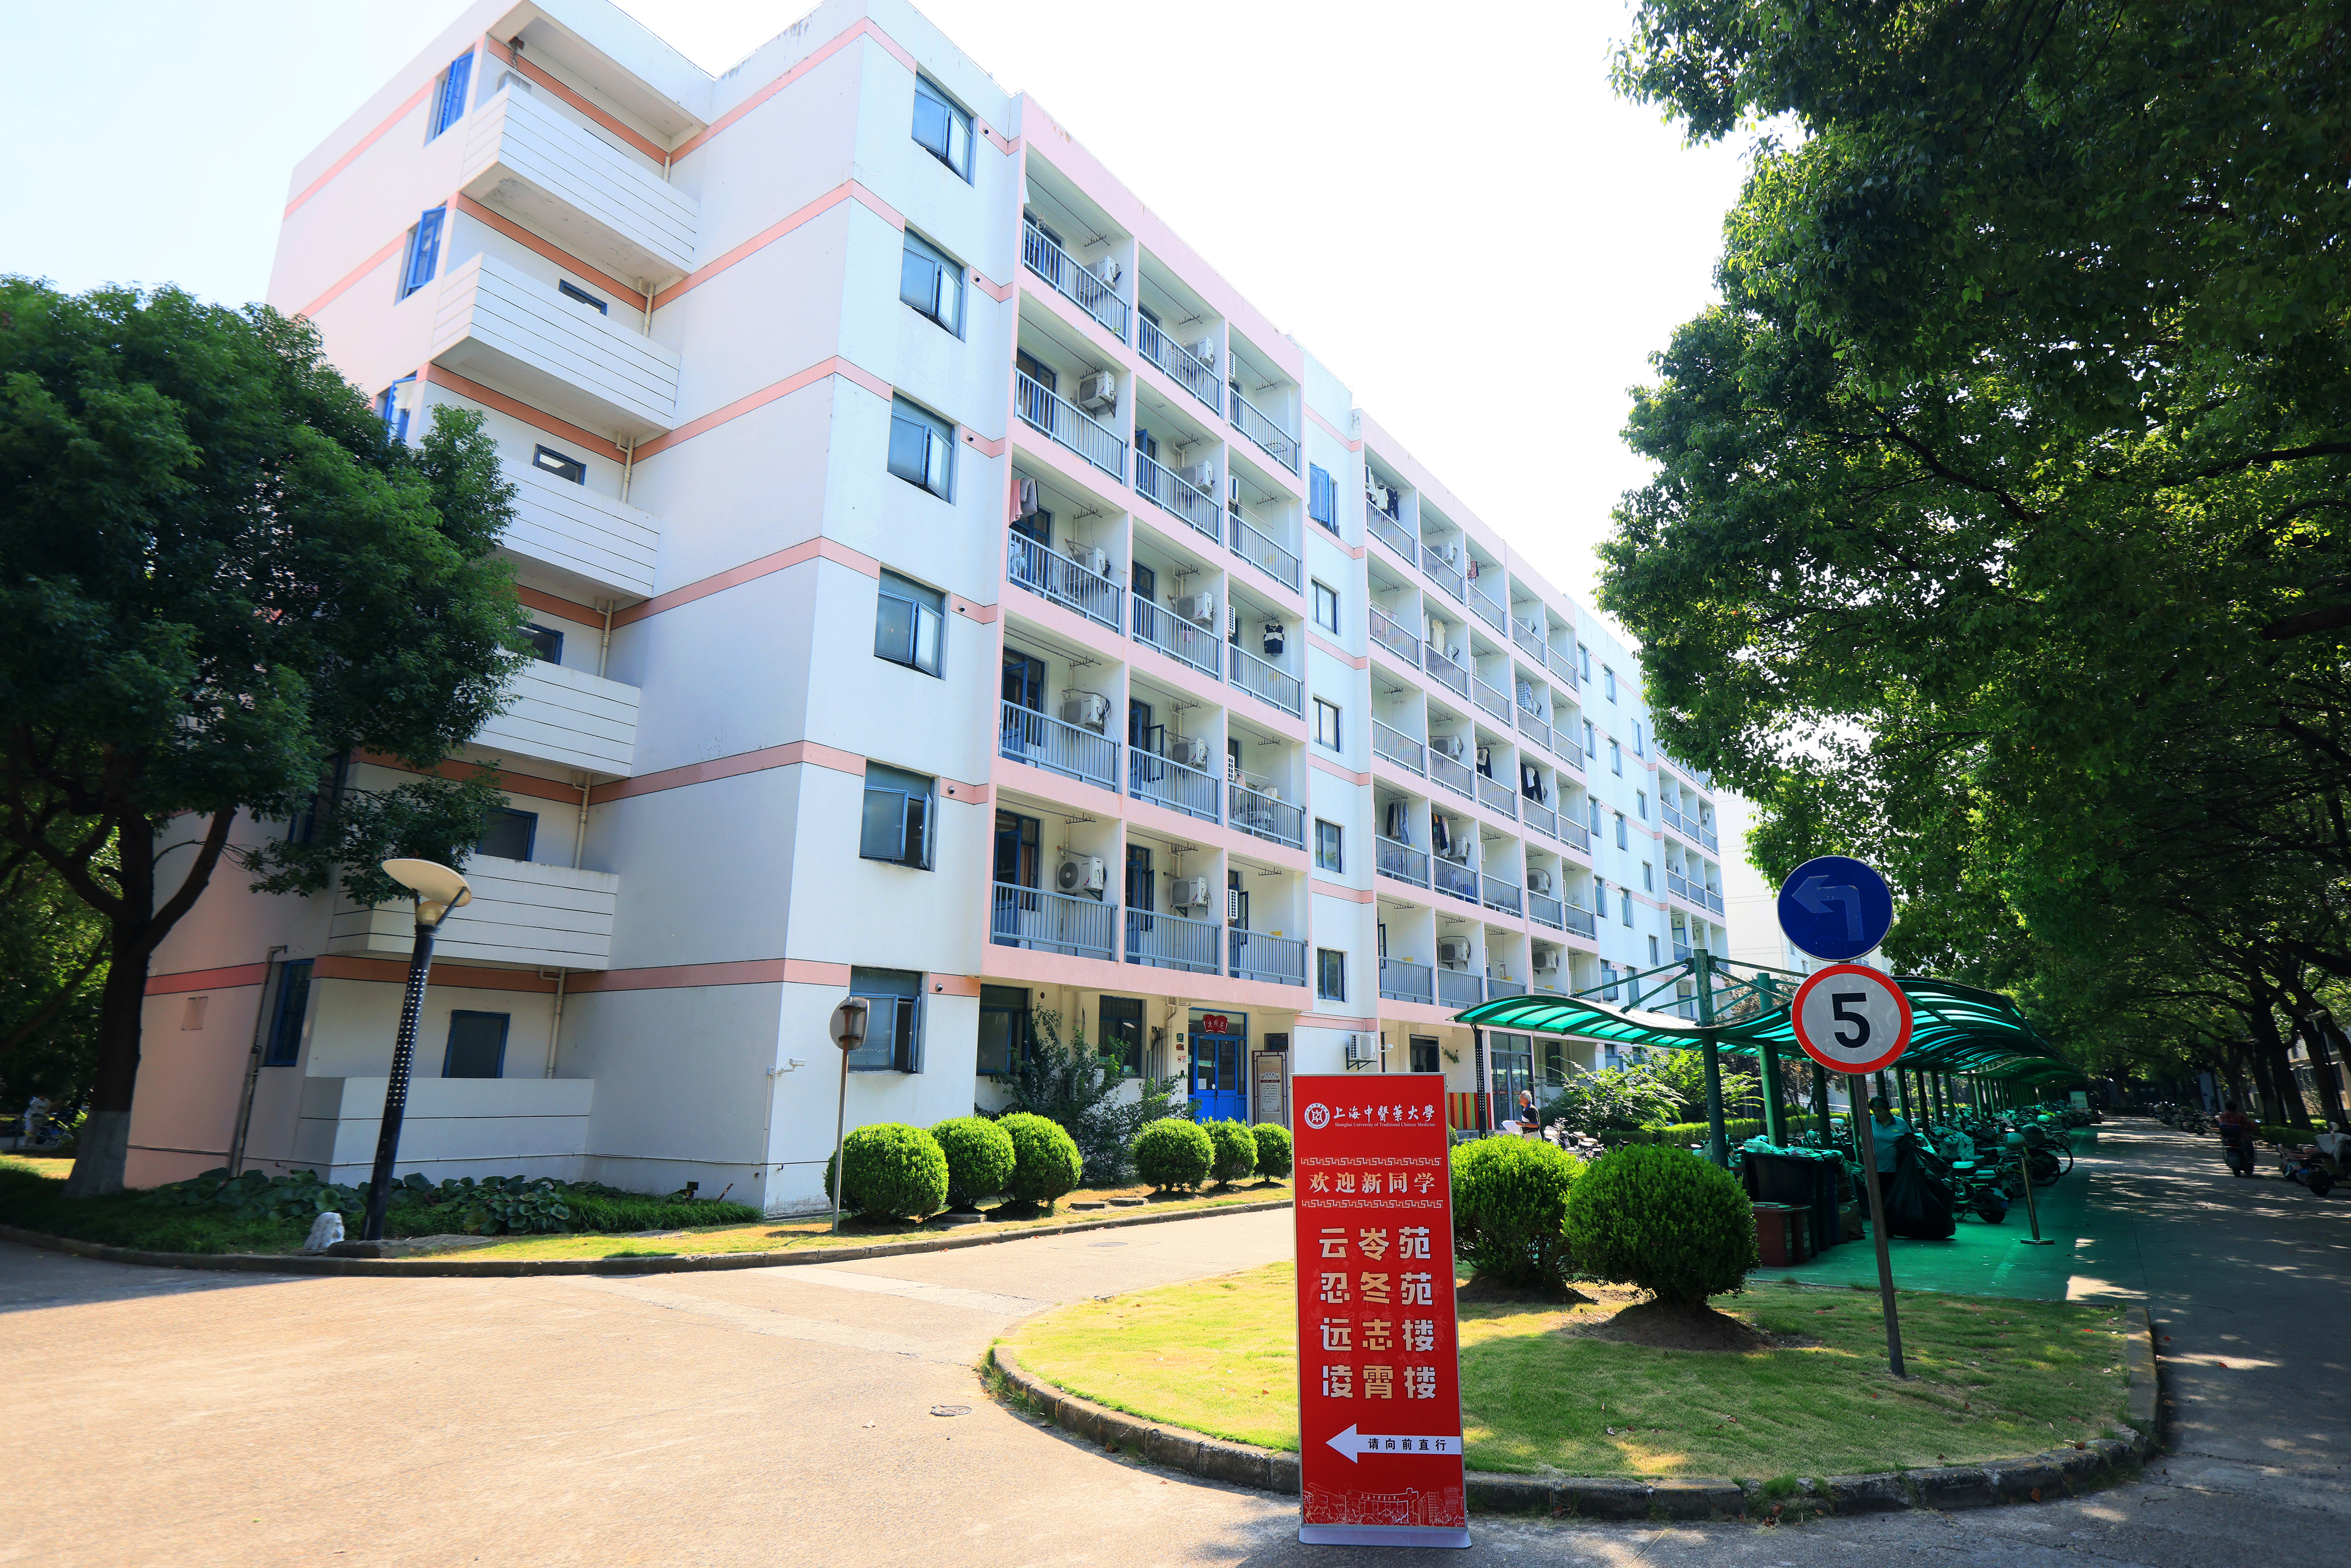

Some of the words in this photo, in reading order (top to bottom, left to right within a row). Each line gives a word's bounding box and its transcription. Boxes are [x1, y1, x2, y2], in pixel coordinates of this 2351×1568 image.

[1831, 993, 1870, 1048] 5
[1309, 1172, 1435, 1194] 欢迎新同学
[1320, 1272, 1433, 1305] 忍冬苑
[1320, 1317, 1434, 1352] 远志楼
[1323, 1364, 1436, 1399] 凌霄楼
[1368, 1438, 1446, 1451] 请向前直行
